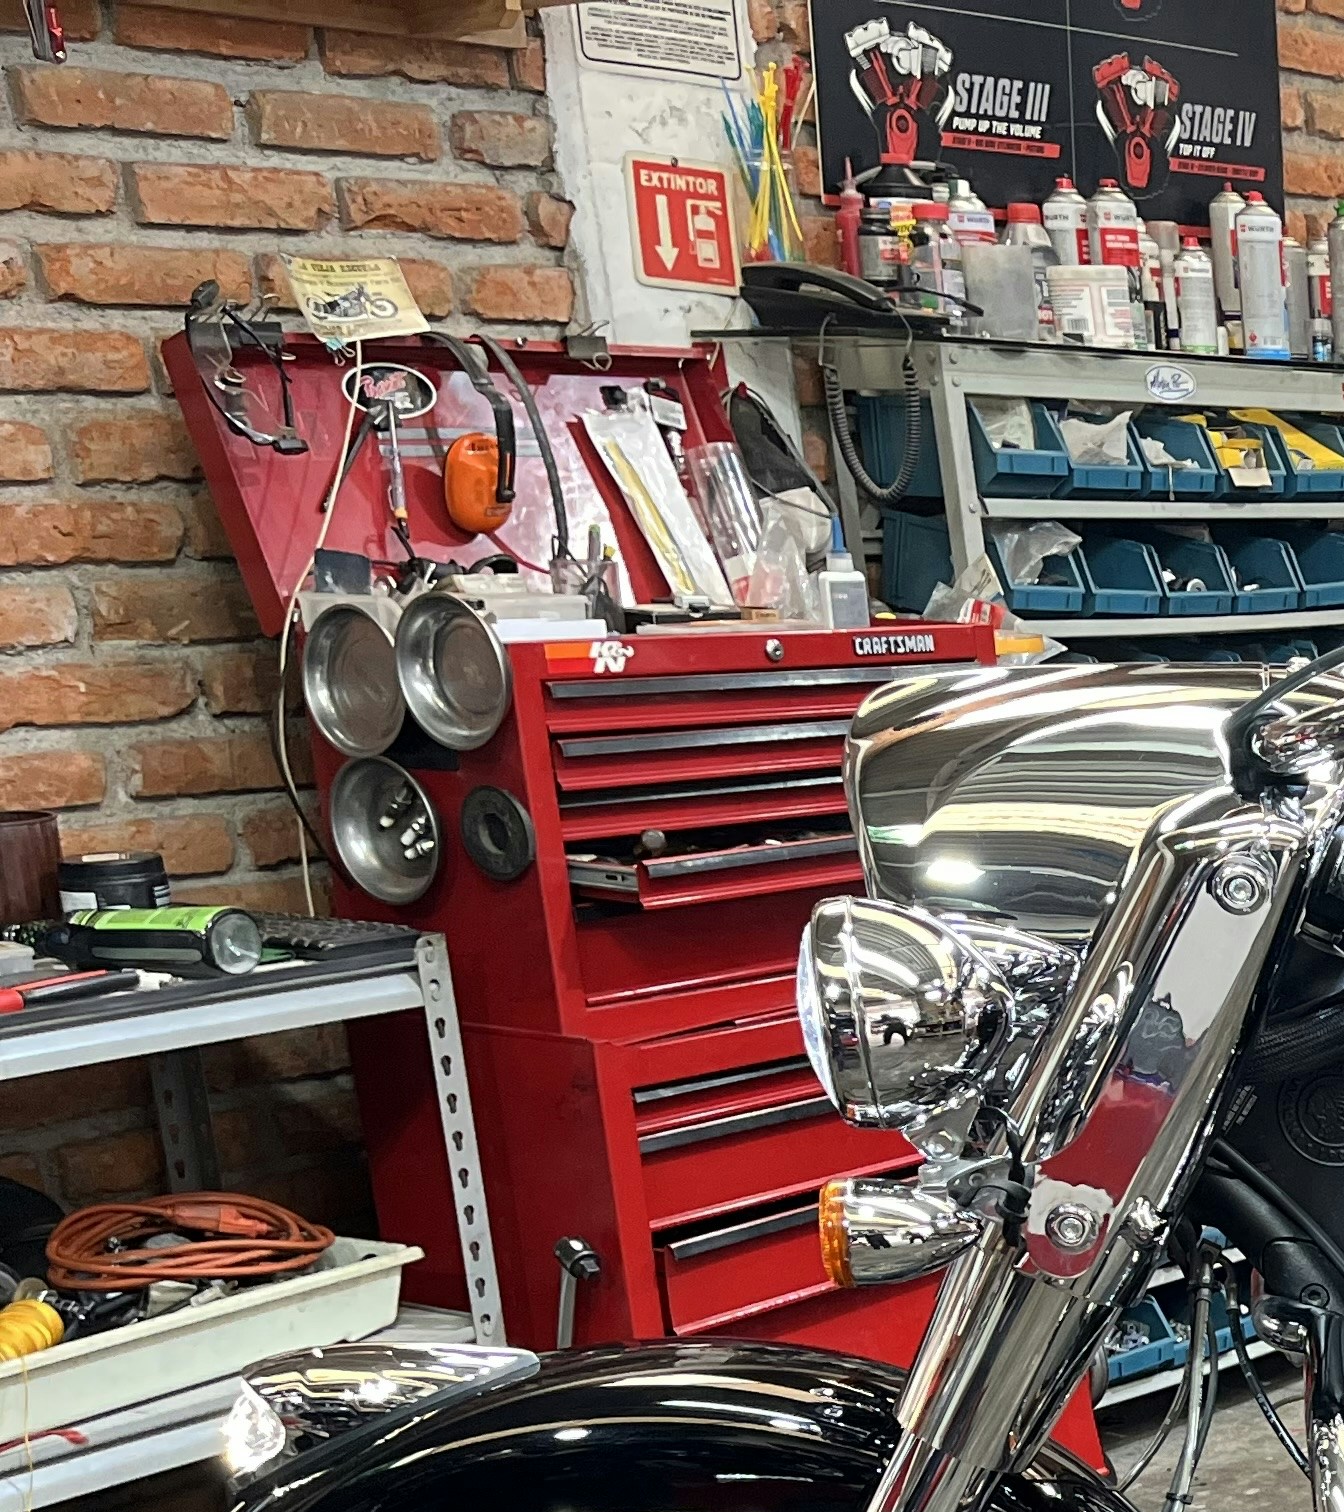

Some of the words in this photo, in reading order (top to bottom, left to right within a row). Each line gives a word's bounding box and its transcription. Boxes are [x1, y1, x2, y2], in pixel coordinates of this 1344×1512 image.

[954, 72, 1022, 118] STAGE
[1024, 83, 1050, 122] III
[1180, 103, 1232, 144] STAGE
[1235, 111, 1257, 147] IV
[639, 168, 718, 196] EXTINTOR
[853, 634, 935, 656] CRAFTSMAN
